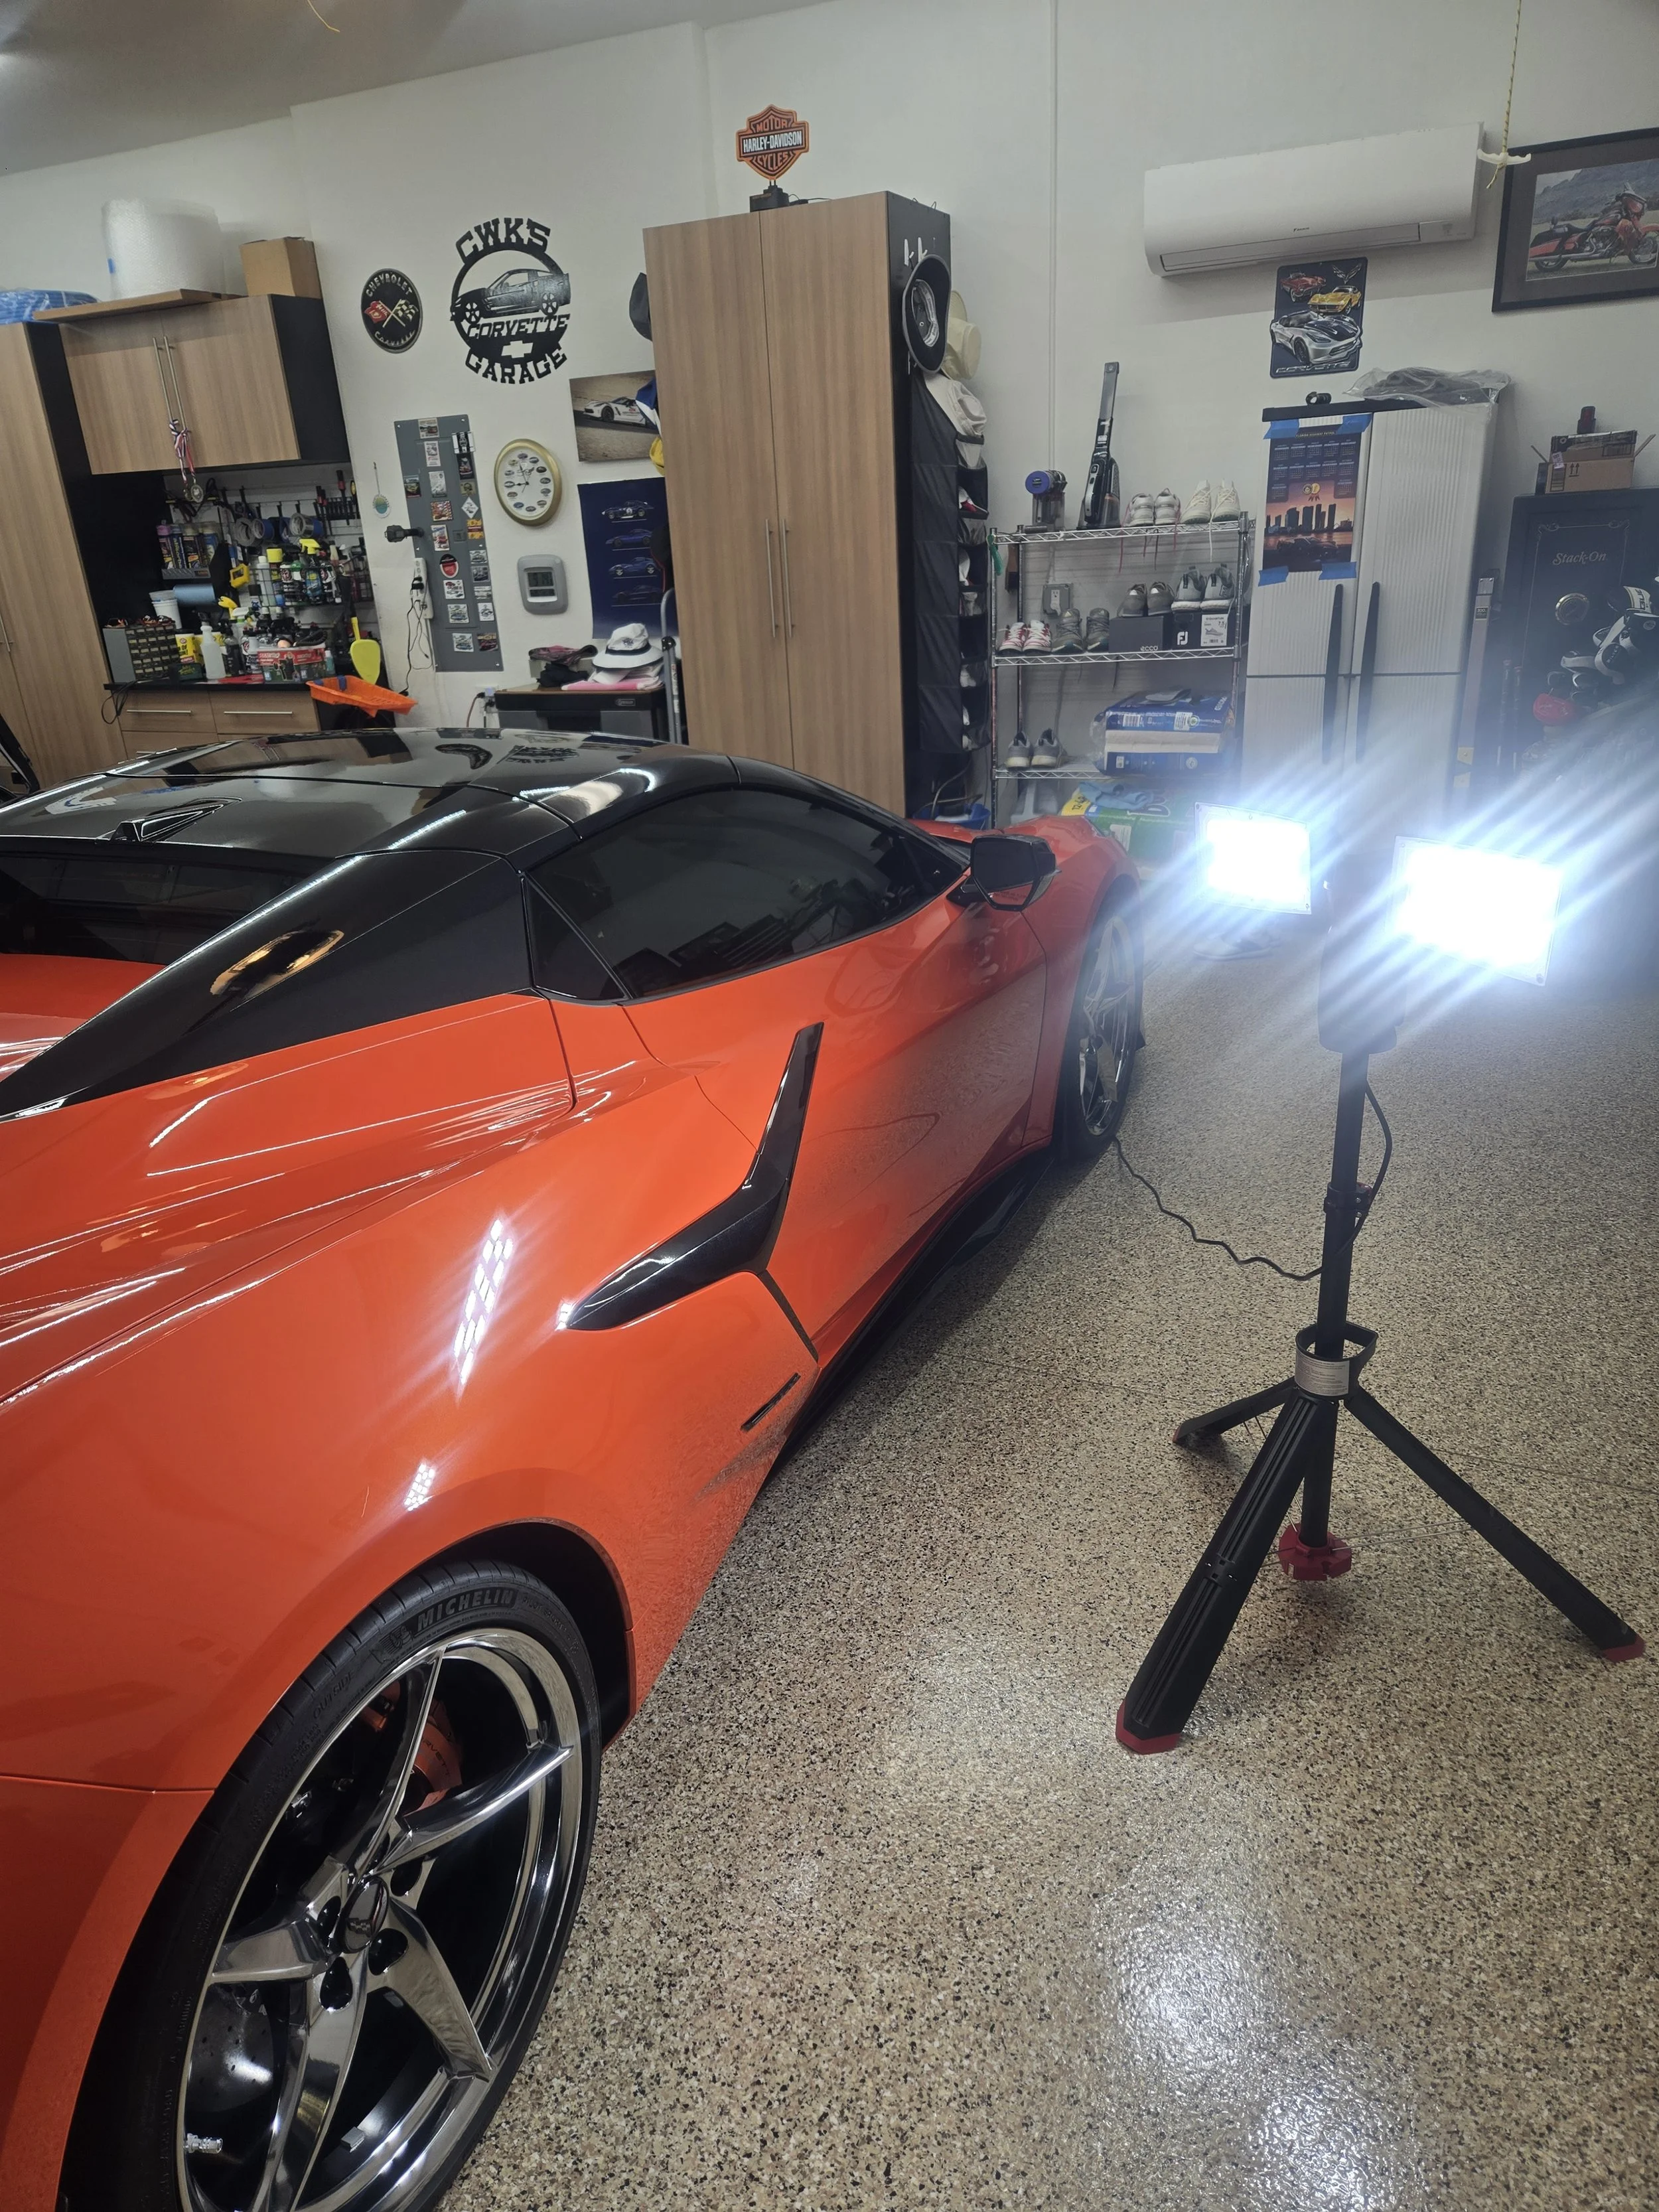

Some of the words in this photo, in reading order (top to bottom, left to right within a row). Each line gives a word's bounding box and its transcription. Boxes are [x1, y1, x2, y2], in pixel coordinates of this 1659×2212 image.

[757, 115, 788, 133] MOTOR
[743, 130, 802, 153] HARLEY-DAVIDSON
[757, 151, 788, 171] CYCLES
[366, 273, 413, 297] CHEVROLET
[467, 313, 571, 339] CORVETTE
[465, 342, 568, 384] GARAGE
[1275, 360, 1351, 374] CORVETTE
[1552, 551, 1607, 565] Stack-On
[1177, 631, 1189, 646] FJ
[416, 1589, 513, 1632] MICHELIN
[313, 1671, 355, 1720] OUTSIDE
